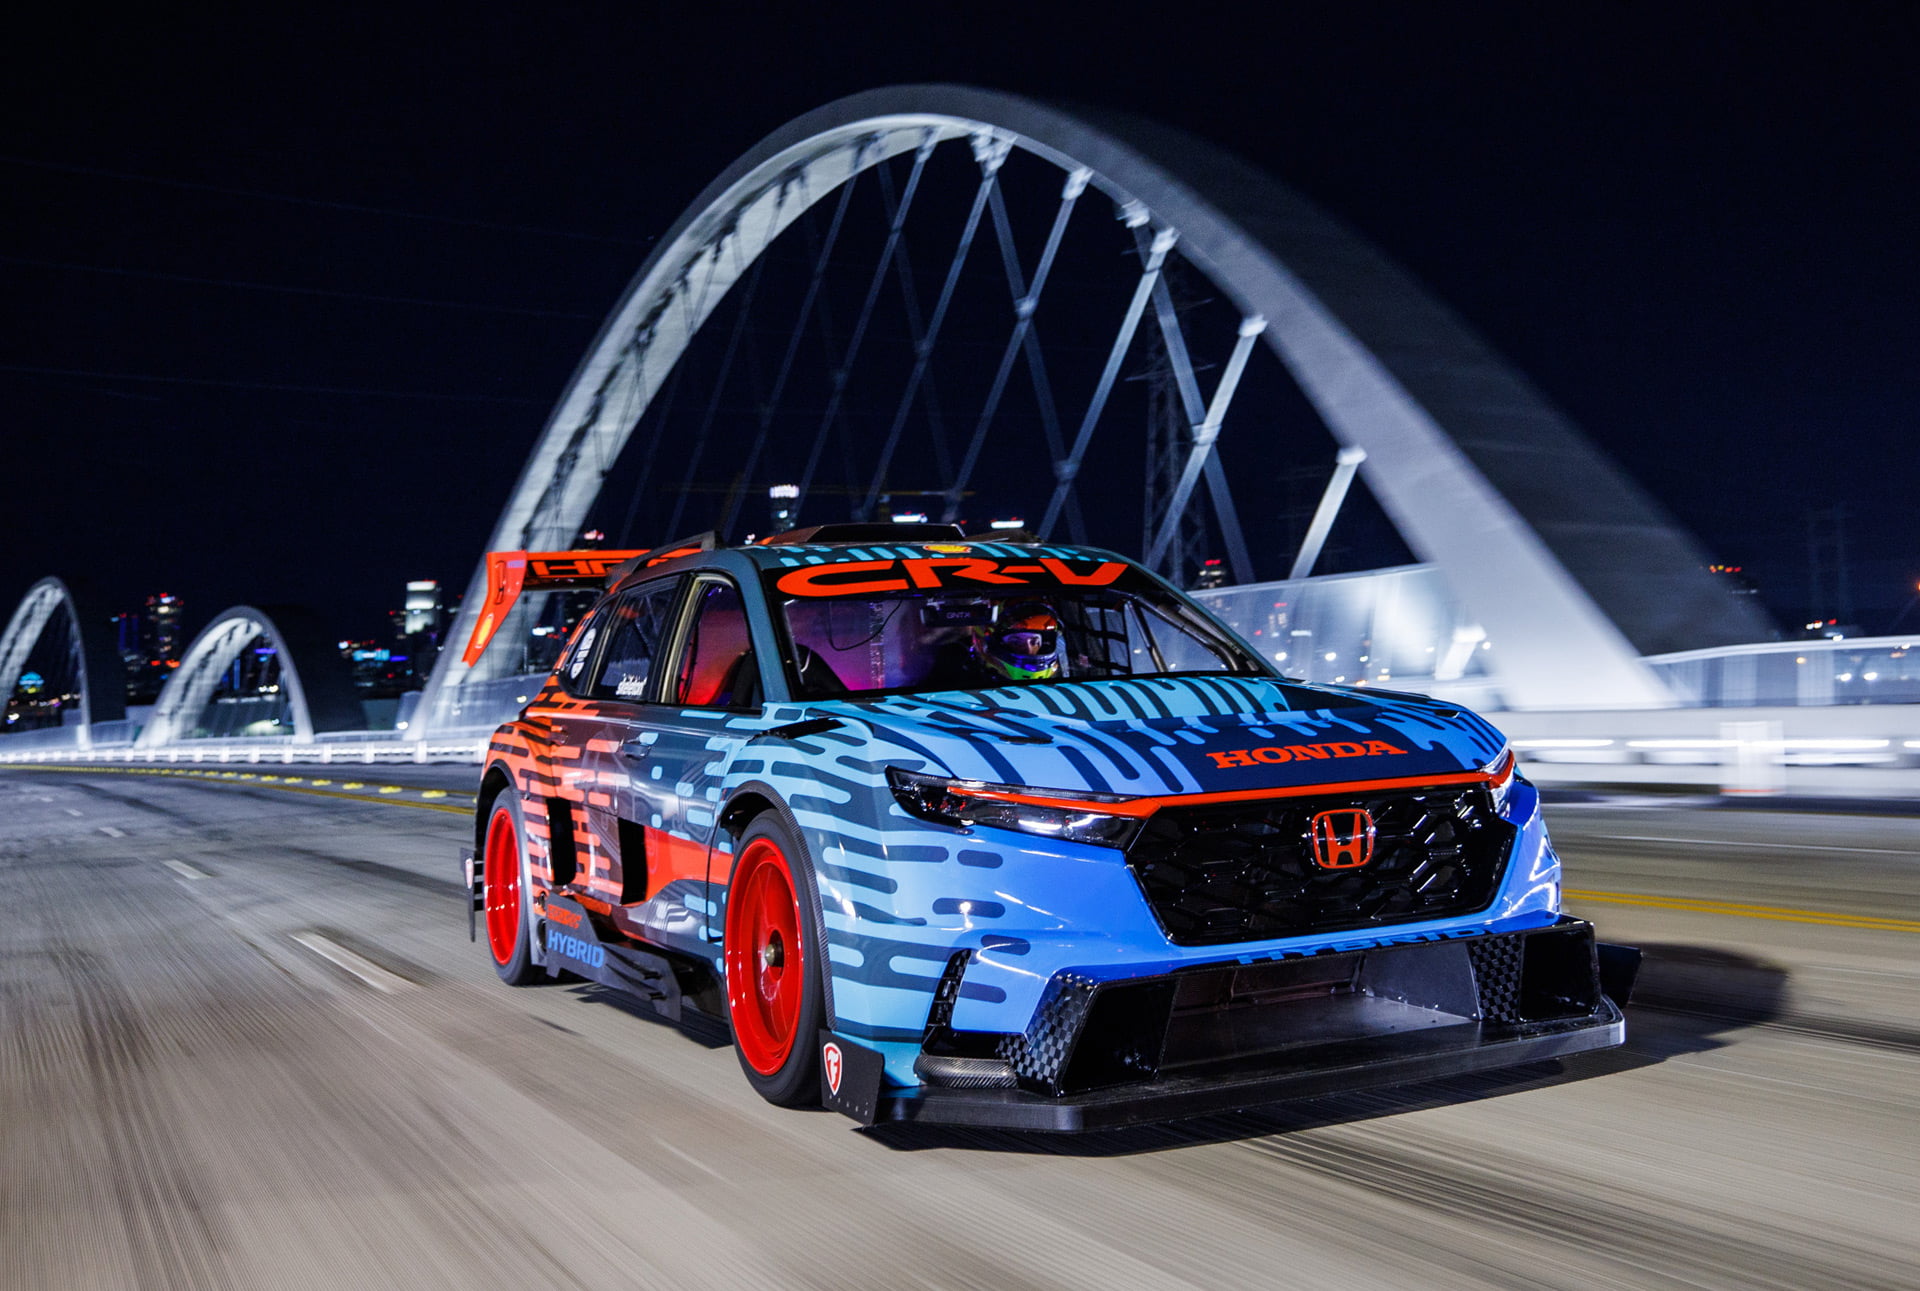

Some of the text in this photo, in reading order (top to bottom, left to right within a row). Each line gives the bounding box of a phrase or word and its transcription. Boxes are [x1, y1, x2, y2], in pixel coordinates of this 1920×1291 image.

[776, 557, 1129, 597] CR-V
[1206, 740, 1409, 768] HONDA
[547, 929, 605, 968] HYBRID
[1237, 926, 1487, 965] HYBRID
